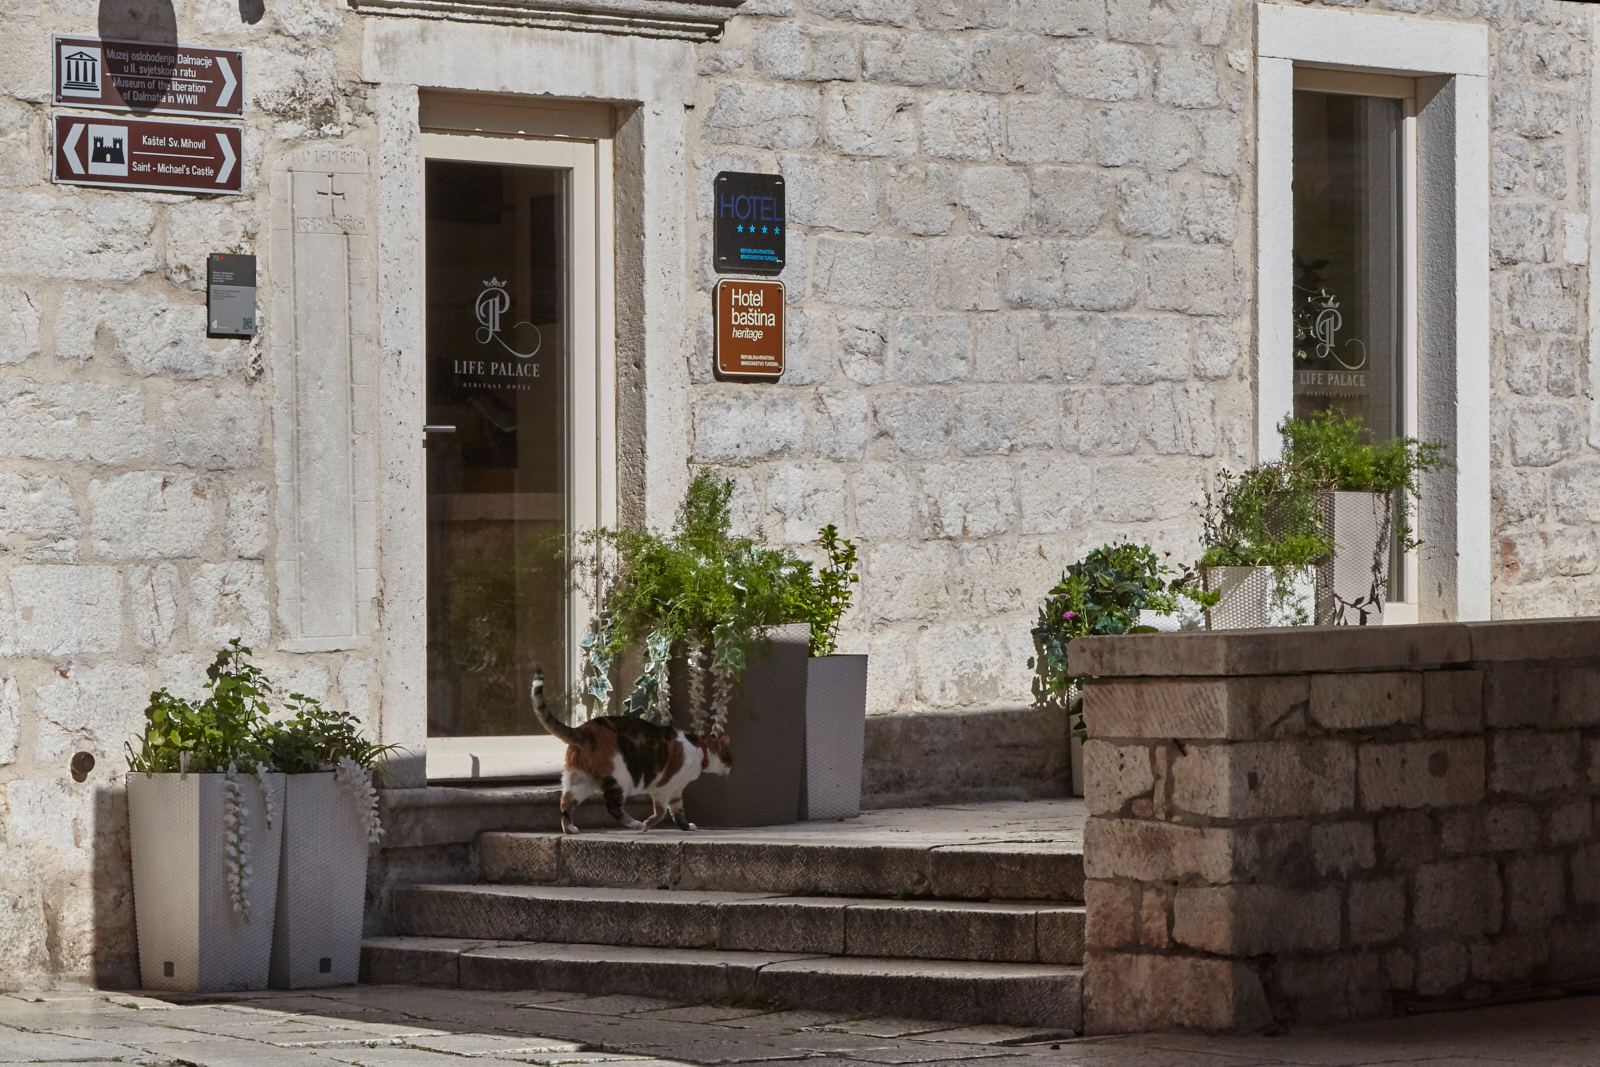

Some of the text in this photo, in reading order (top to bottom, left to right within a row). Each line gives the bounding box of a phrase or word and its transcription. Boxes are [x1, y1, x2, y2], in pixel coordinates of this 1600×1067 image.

[106, 48, 212, 68] Muzej oslobođenja Dalmacije
[124, 65, 128, 73] u
[139, 64, 177, 76] svjetskom
[180, 68, 196, 78] ratu
[113, 76, 206, 93] Museum of the liberation
[122, 90, 198, 105] of Dalmatia in WWII
[142, 135, 206, 150] Kaštel Sv. Mihovil
[132, 161, 151, 172] Saint
[157, 162, 190, 175] Michael's
[192, 165, 214, 176] Castle
[720, 194, 784, 222] HOTEL
[732, 288, 764, 306] Hotel
[732, 308, 776, 326] baština
[732, 327, 764, 342] heritage
[454, 360, 540, 378] LIFE PALACE
[1300, 372, 1366, 386] LIFE PALACE
